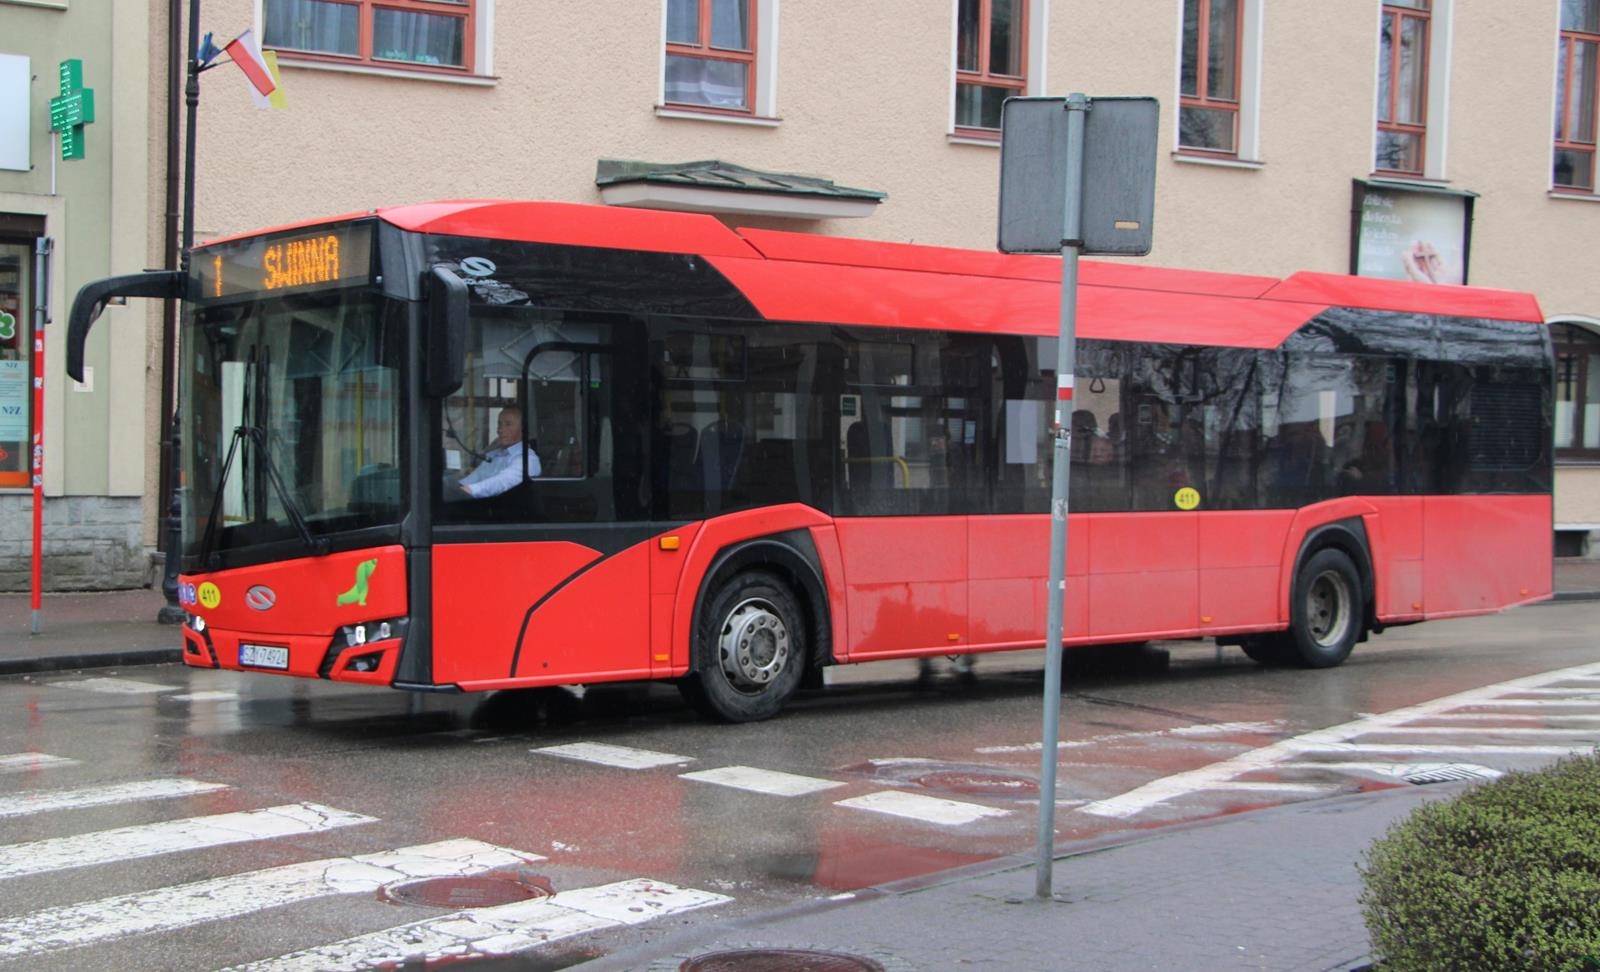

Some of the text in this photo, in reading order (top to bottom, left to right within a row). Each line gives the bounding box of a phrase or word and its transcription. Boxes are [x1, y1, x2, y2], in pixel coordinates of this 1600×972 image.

[213, 255, 223, 297] 1
[1178, 493, 1195, 505] 411
[202, 588, 217, 603] 411
